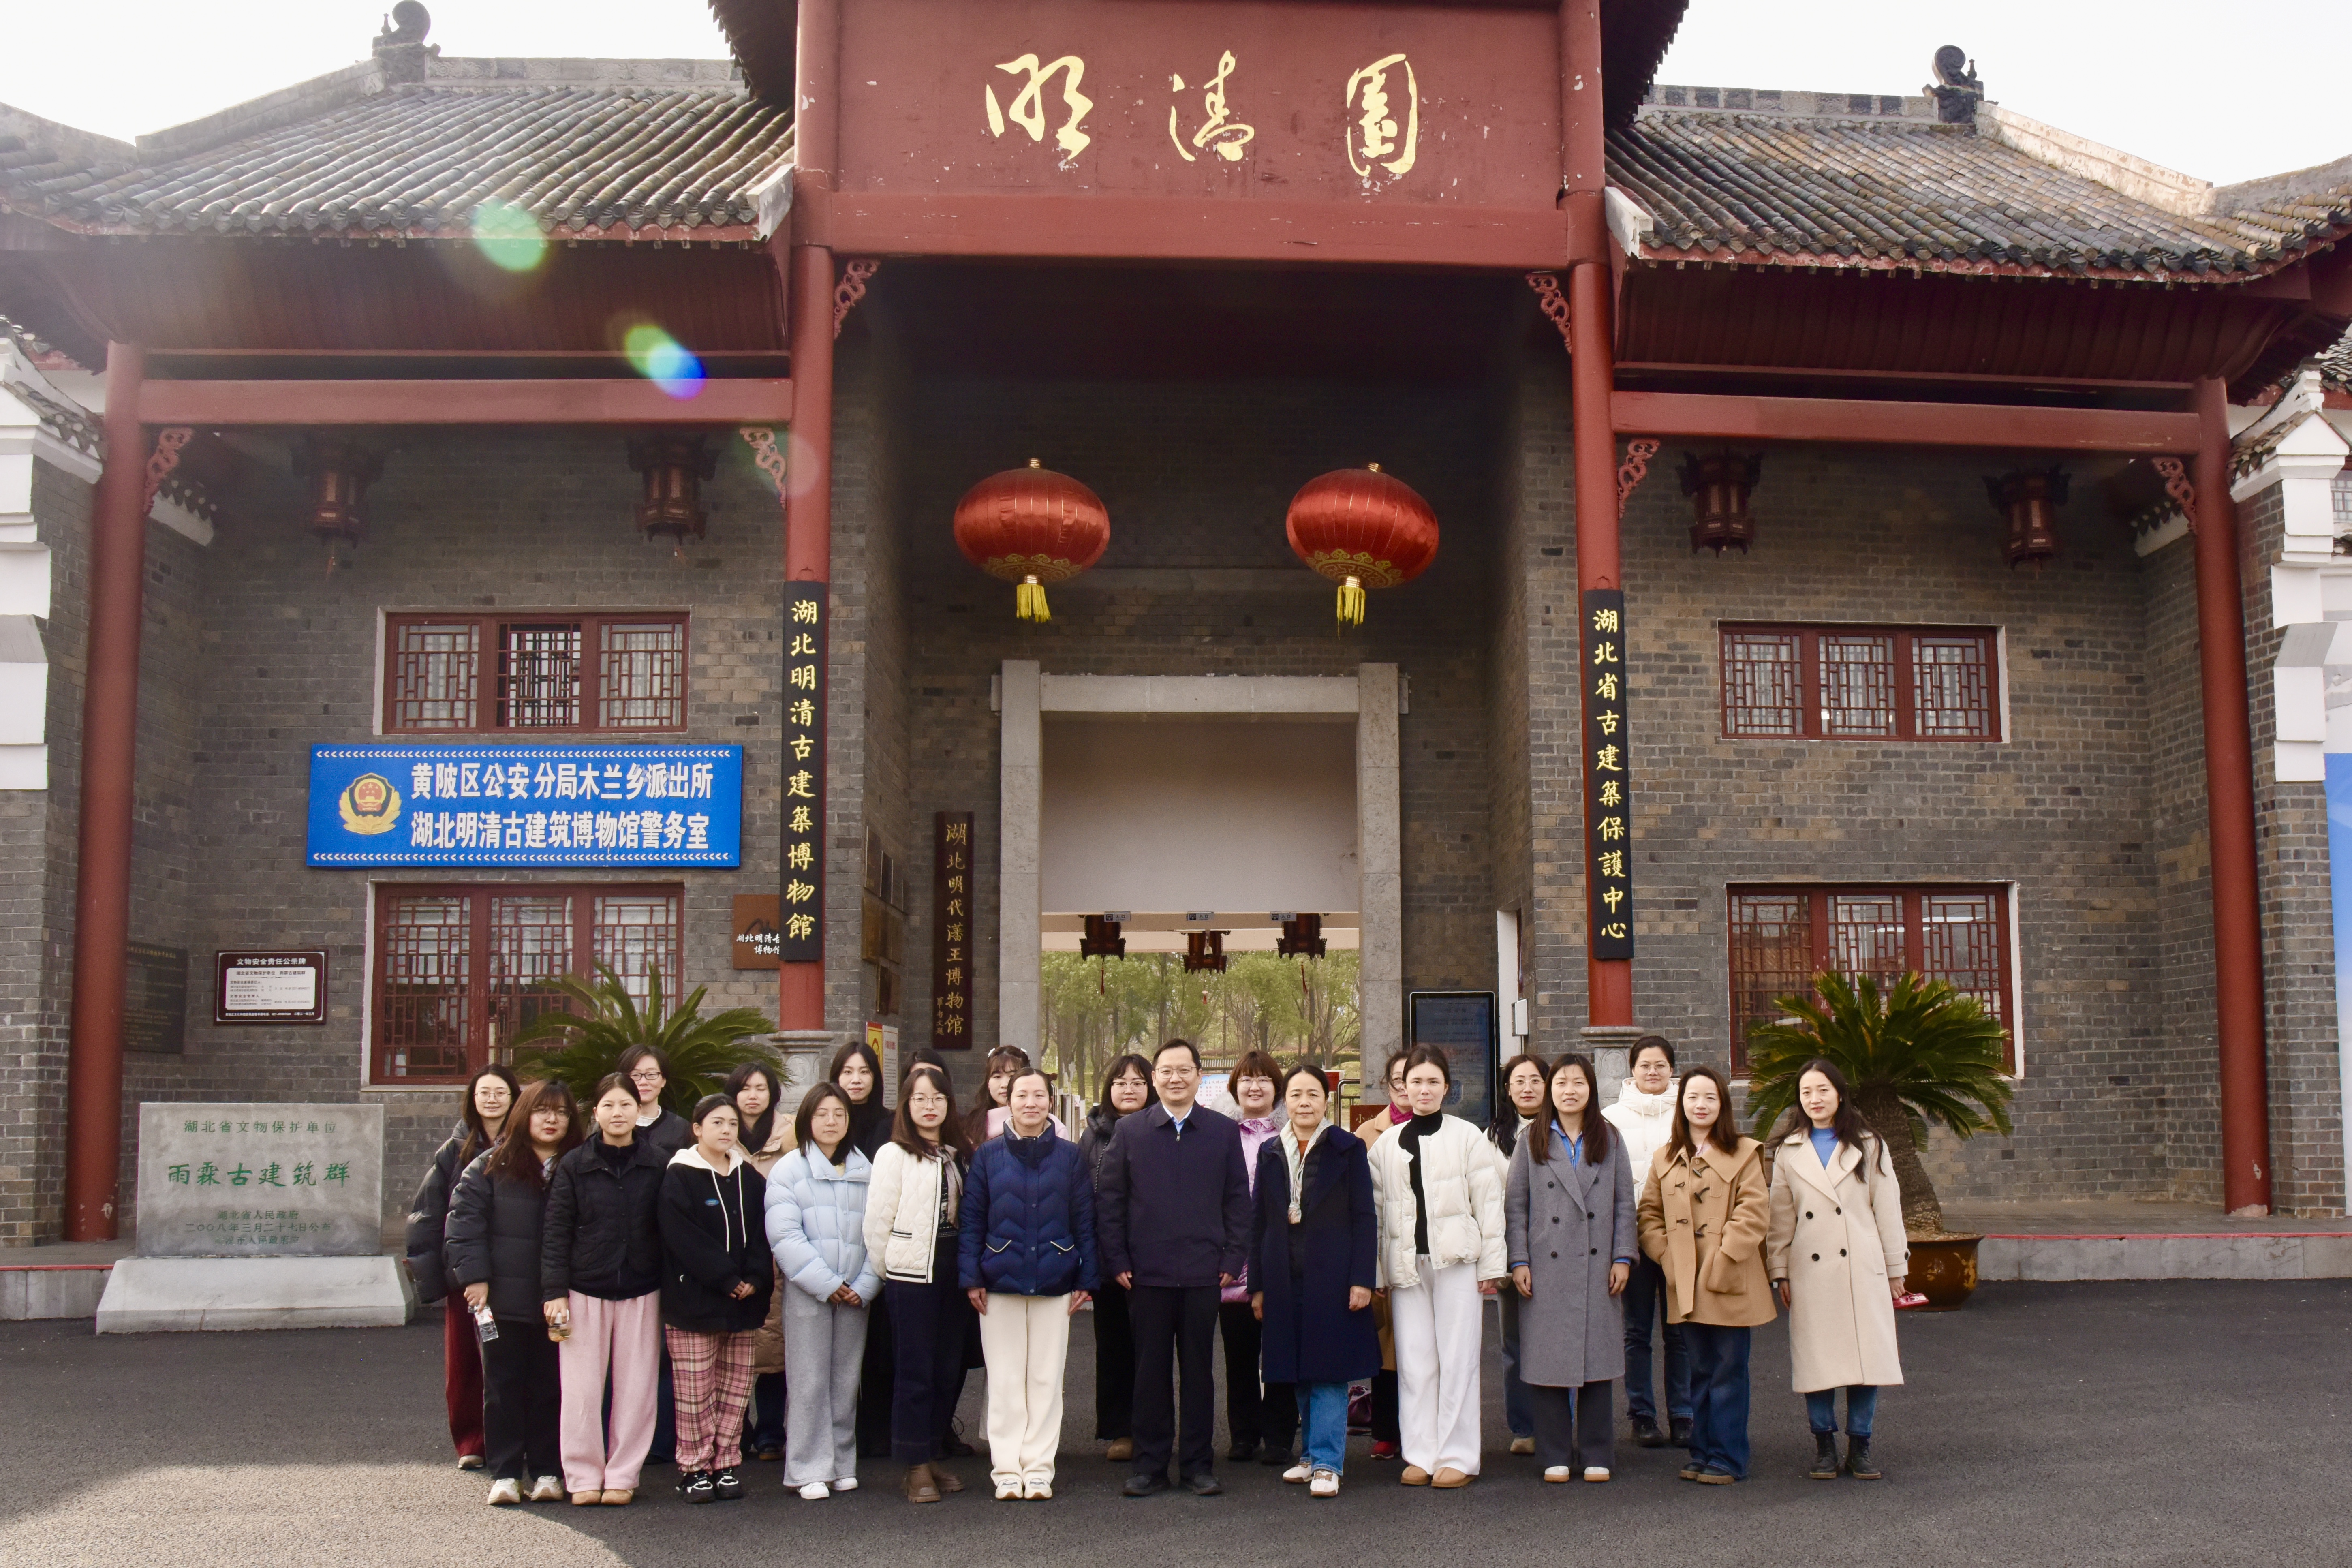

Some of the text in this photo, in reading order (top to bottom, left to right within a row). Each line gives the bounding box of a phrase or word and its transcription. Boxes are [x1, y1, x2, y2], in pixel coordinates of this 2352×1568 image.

[411, 762, 713, 800] 黄陂区公安分局木兰乡派出所
[1594, 609, 1627, 939] 湖北省古建築保護中心
[411, 811, 709, 849] 湖北明清古建筑博物馆警务室
[754, 945, 780, 954] 博物馆
[184, 1120, 337, 1134] 湖北省文物保护单位
[169, 1160, 351, 1188] 雨霖古建筑群
[217, 1210, 299, 1220] 湖北省人民政府
